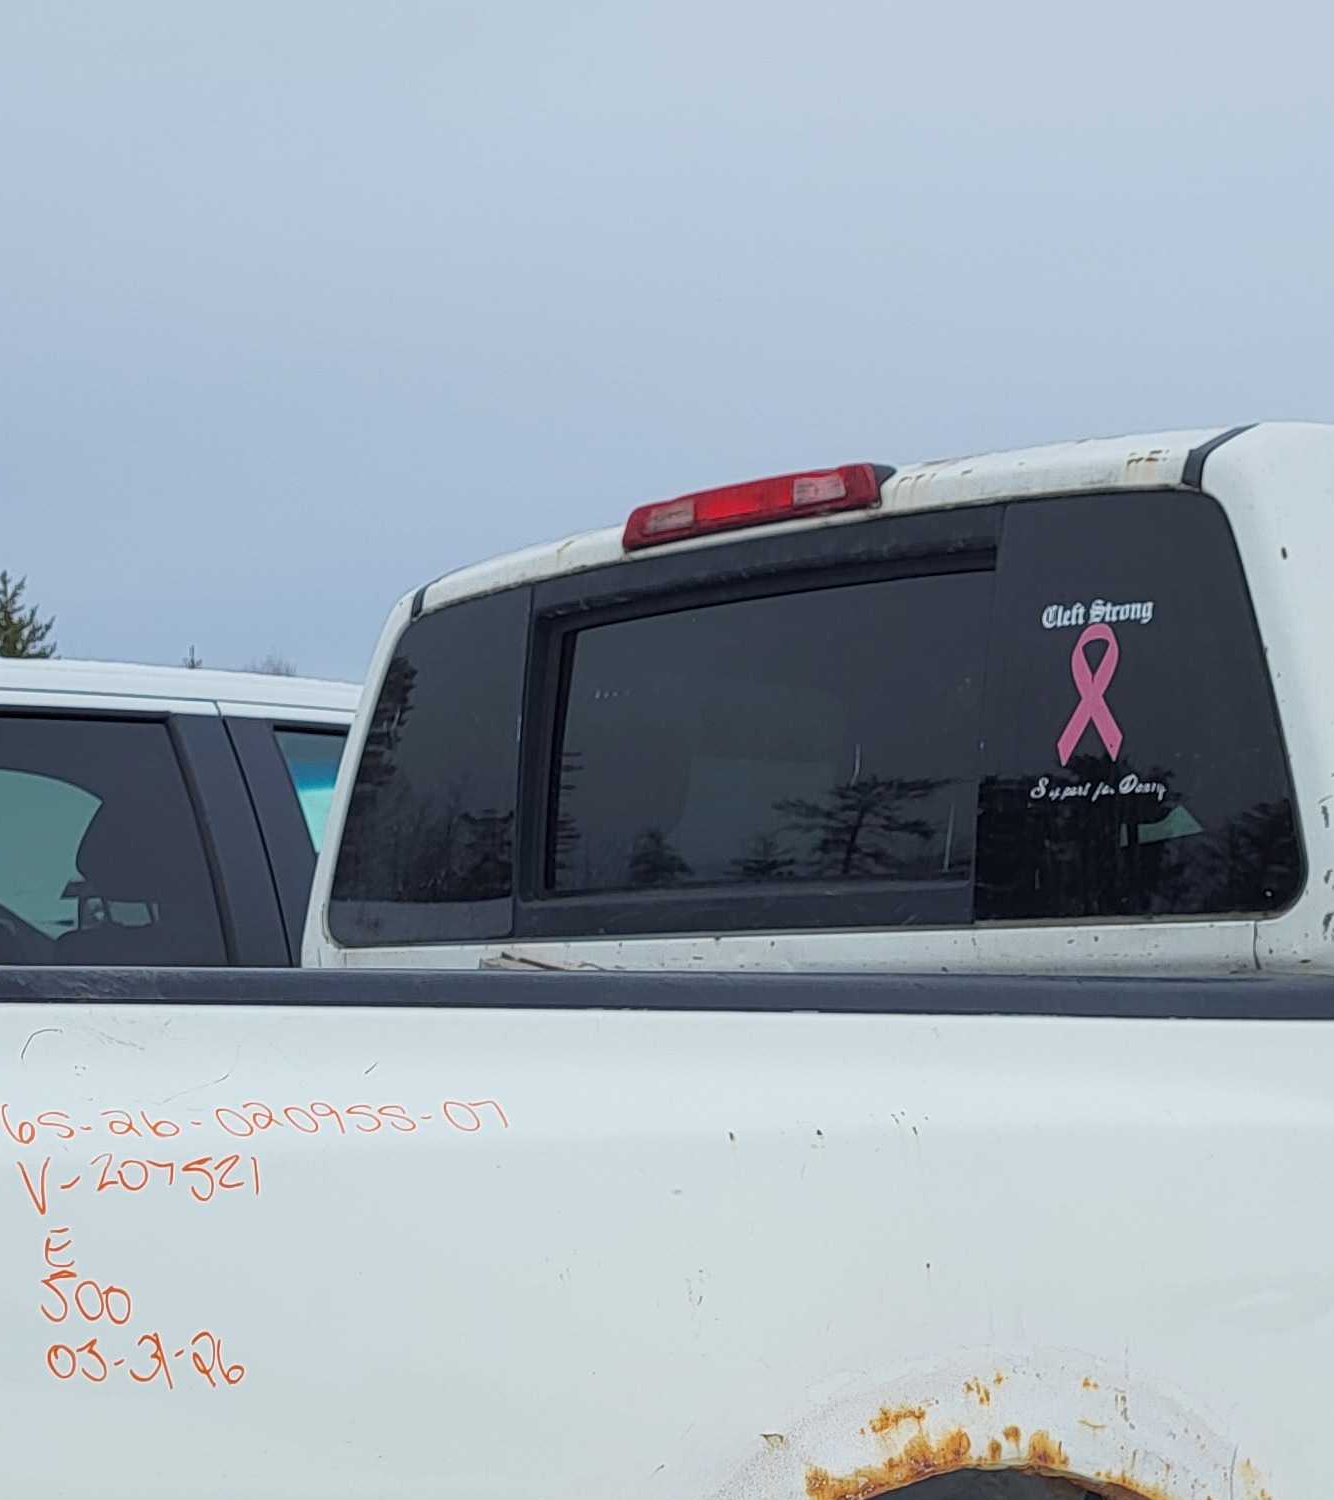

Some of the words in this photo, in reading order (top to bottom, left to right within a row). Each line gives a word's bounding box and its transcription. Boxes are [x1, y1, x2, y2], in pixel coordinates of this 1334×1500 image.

[1041, 605, 1085, 629] Cleft
[1088, 599, 1154, 624] Strong
[1, 1100, 510, 1145] 65-26-020955-07
[16, 1153, 260, 1215] V-207521
[40, 1269, 132, 1325] 500
